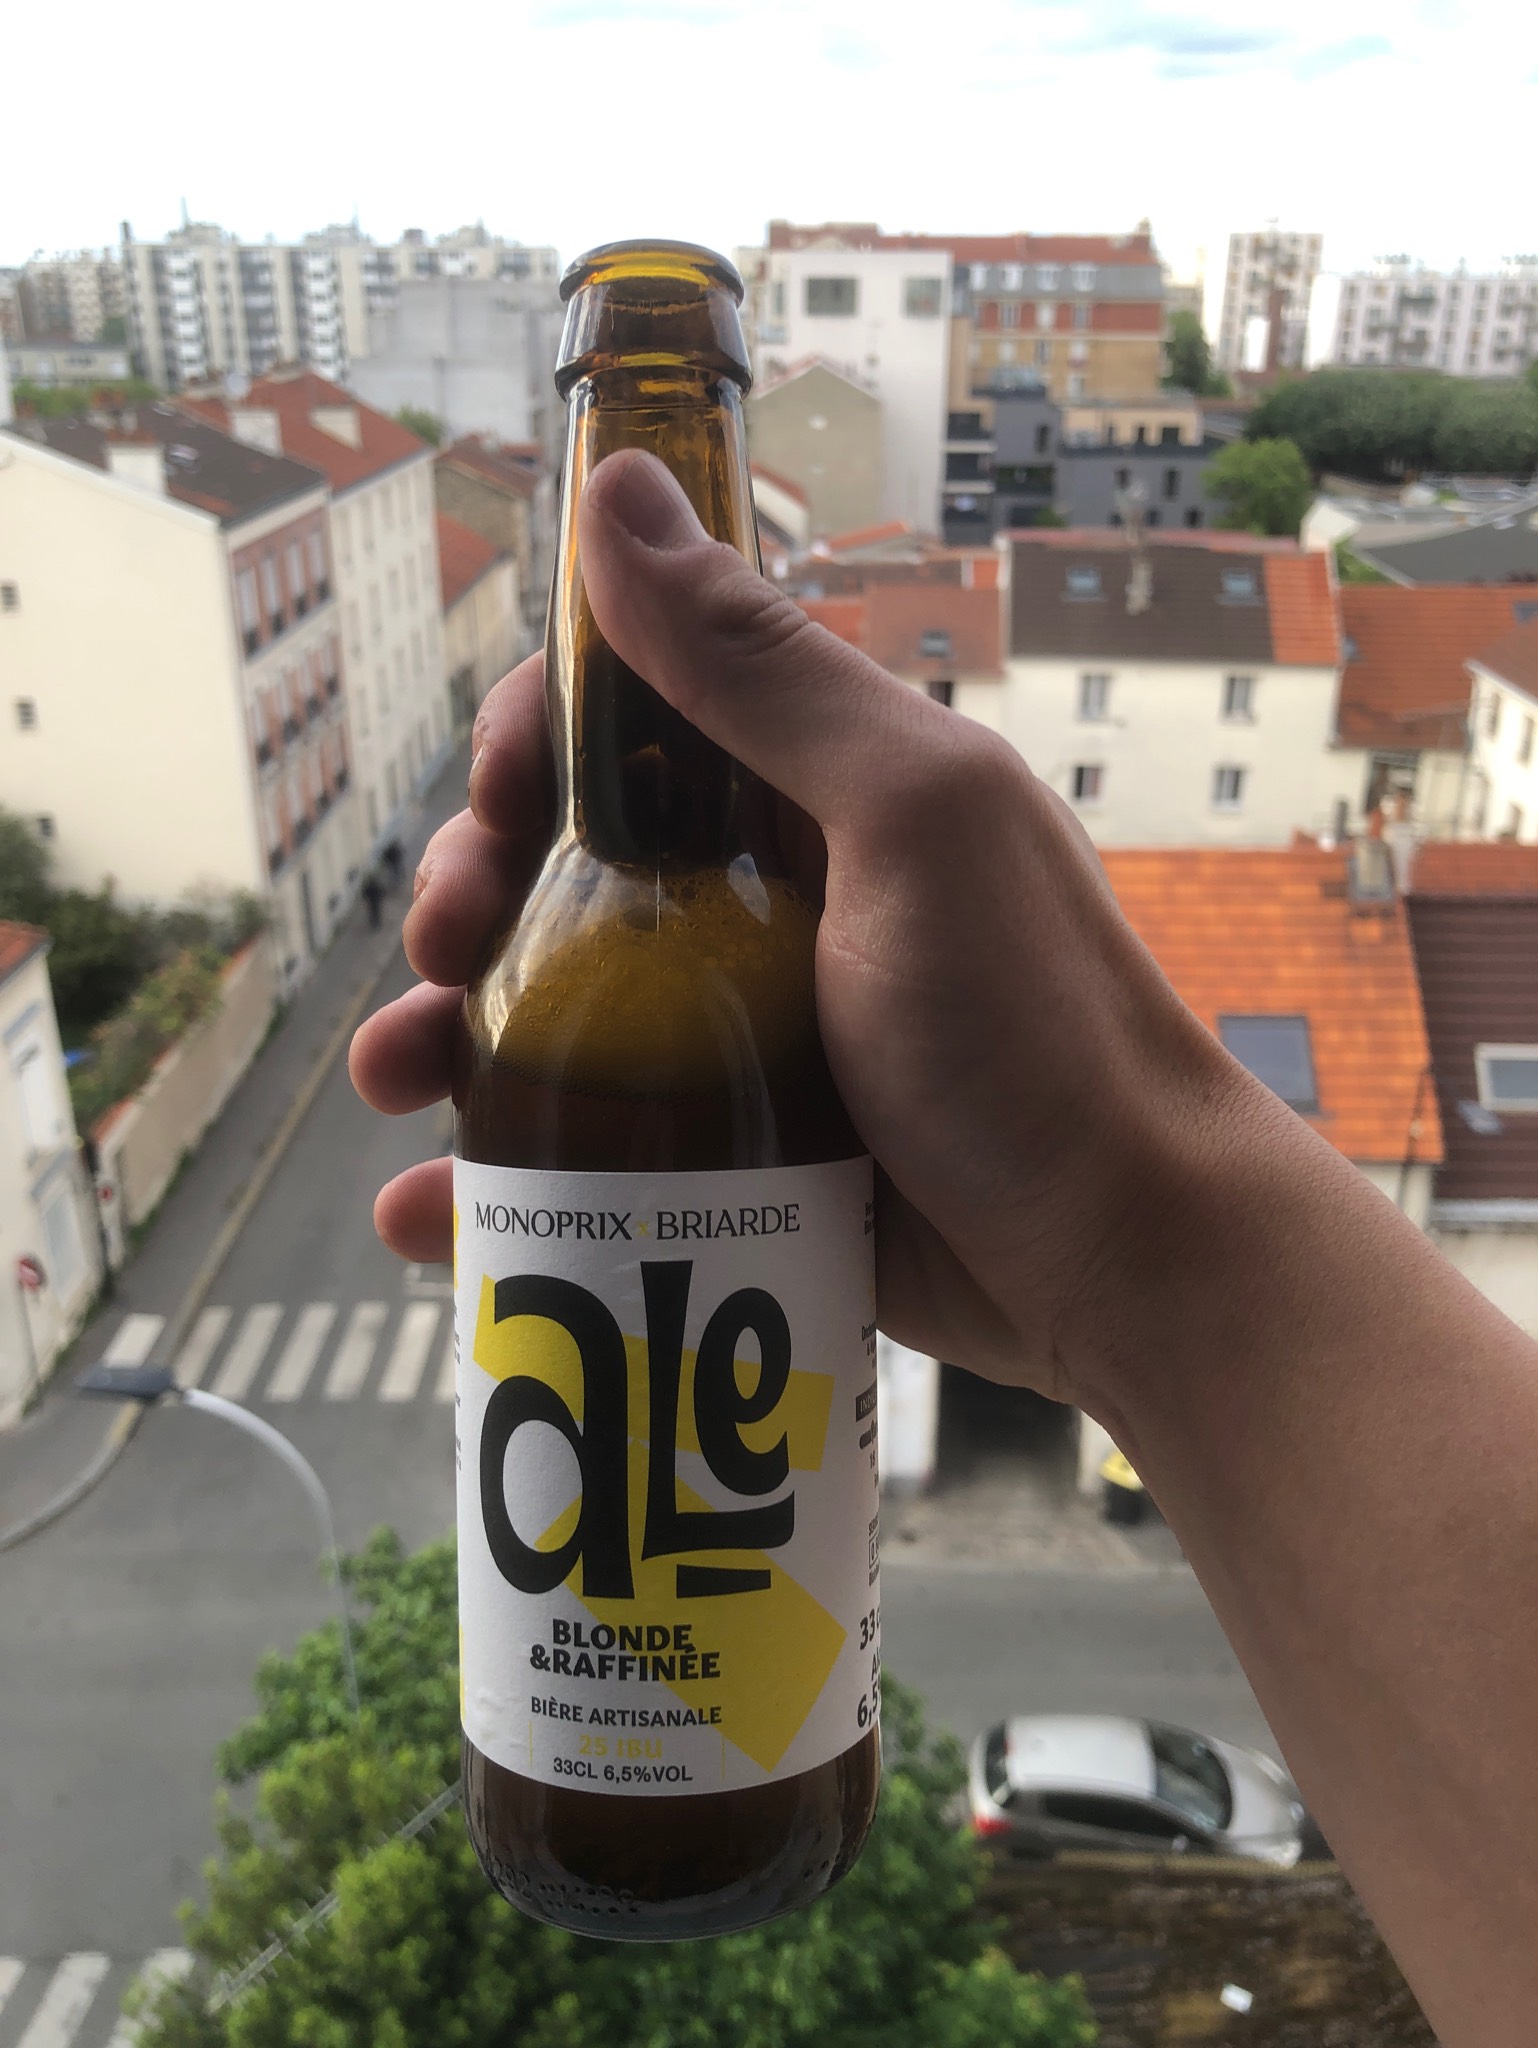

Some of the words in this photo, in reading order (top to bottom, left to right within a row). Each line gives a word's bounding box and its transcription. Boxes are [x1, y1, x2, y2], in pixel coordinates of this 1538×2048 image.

[475, 1202, 632, 1240] MONOPRIX
[656, 1203, 800, 1240] BRIARDE
[552, 1618, 693, 1651] BLONDE
[530, 1643, 721, 1682] &RAFFINÉE
[531, 1696, 584, 1724] BIÈRE
[588, 1706, 722, 1727] ARTISANALE
[578, 1734, 608, 1756] 25
[616, 1738, 663, 1759] IBU
[553, 1757, 598, 1779] 33CL
